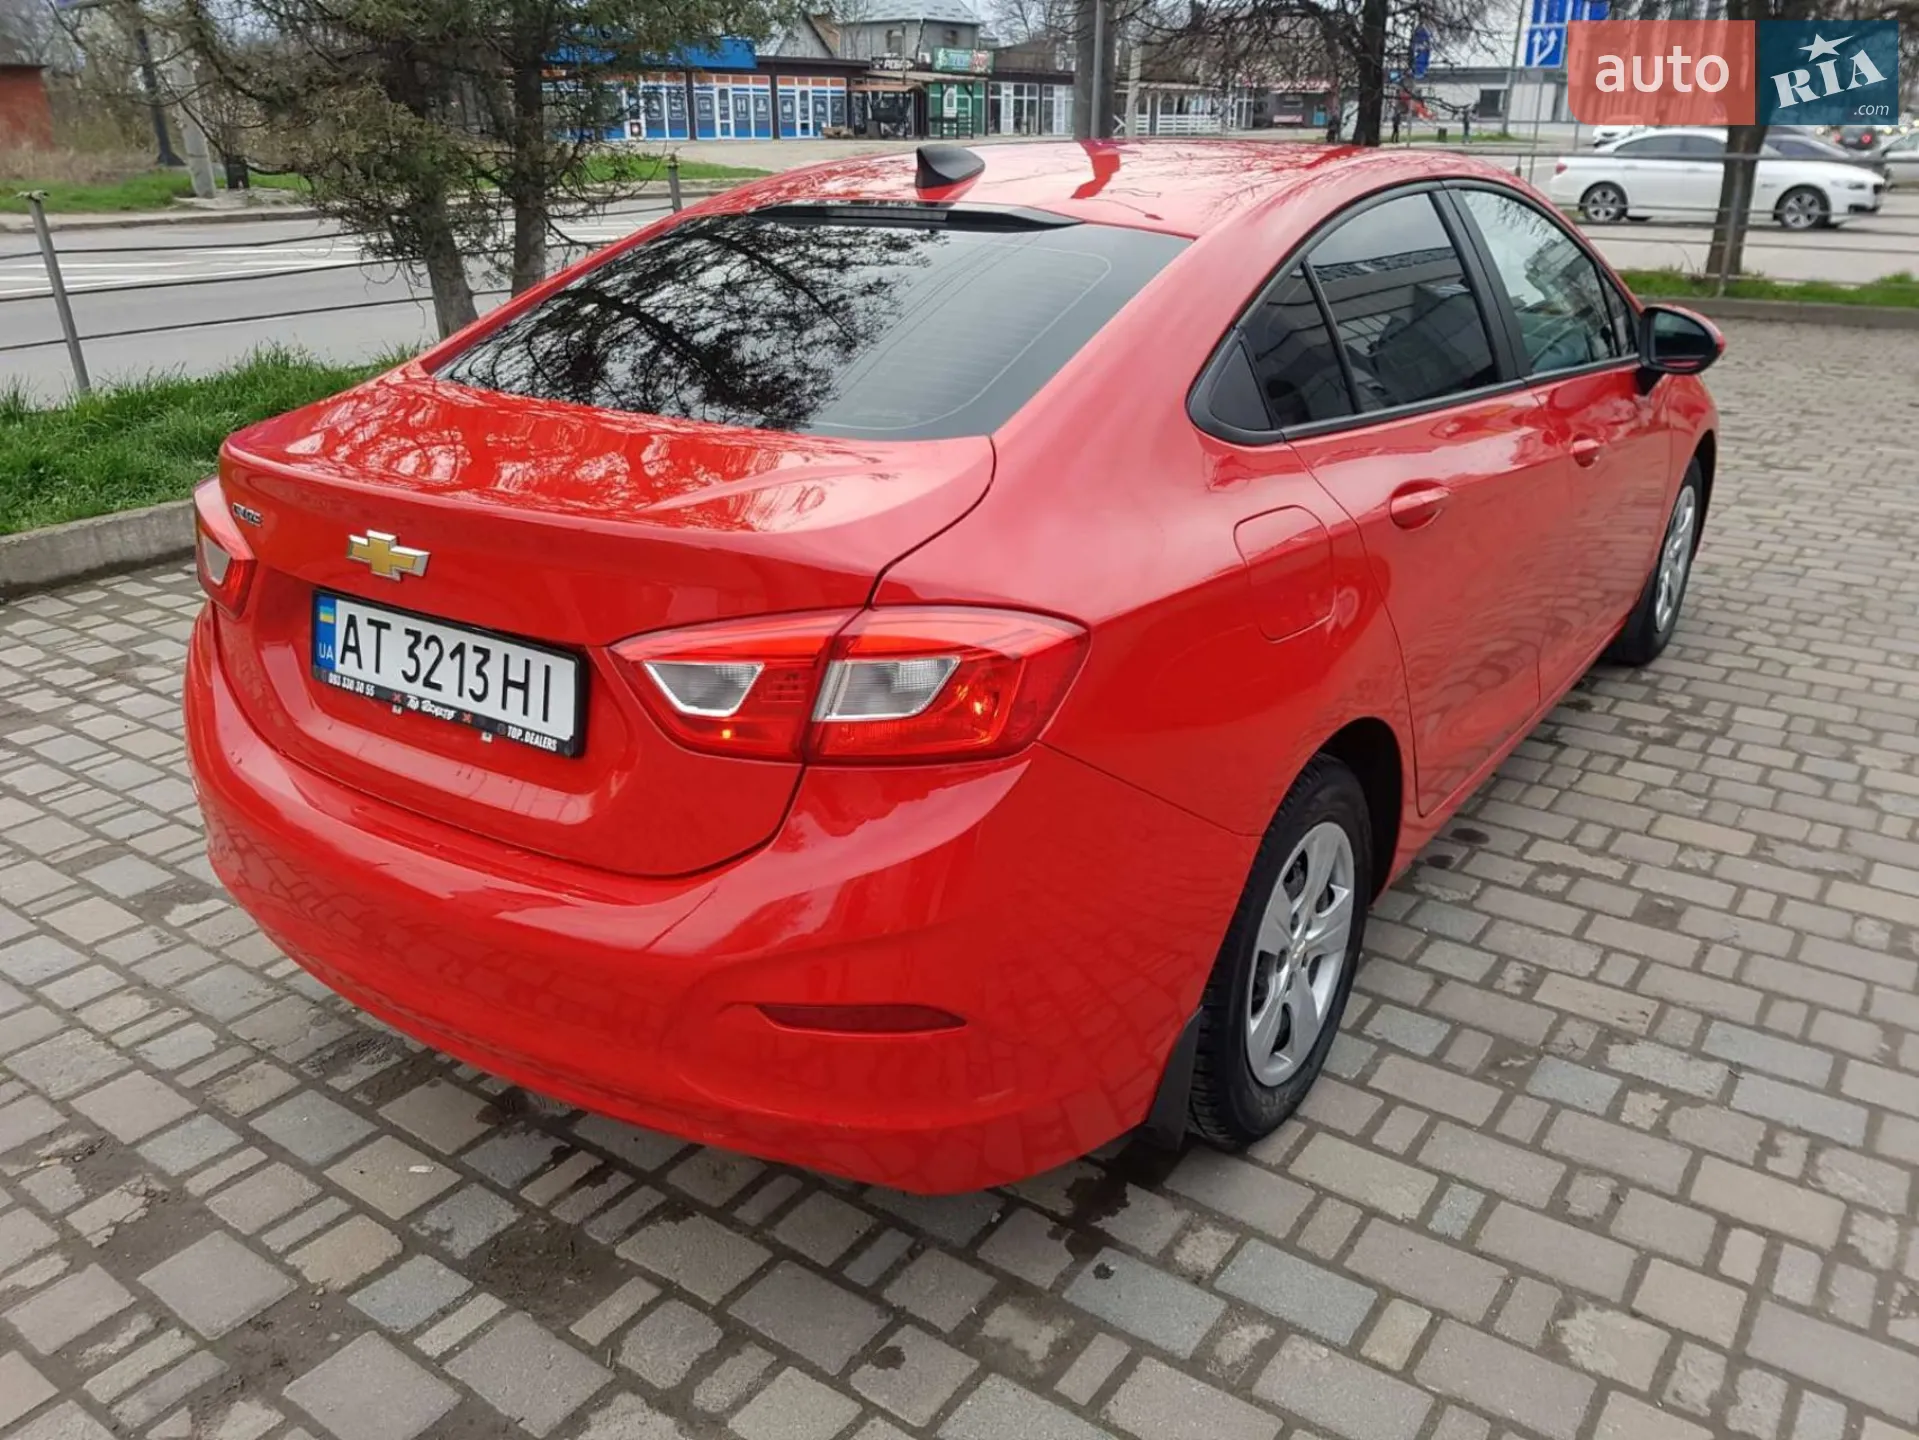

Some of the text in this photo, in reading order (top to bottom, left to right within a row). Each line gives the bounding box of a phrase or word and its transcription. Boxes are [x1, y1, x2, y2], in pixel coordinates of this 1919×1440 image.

[318, 642, 334, 661] UA
[340, 613, 551, 722] AT 3213 HI
[365, 684, 376, 697] 55
